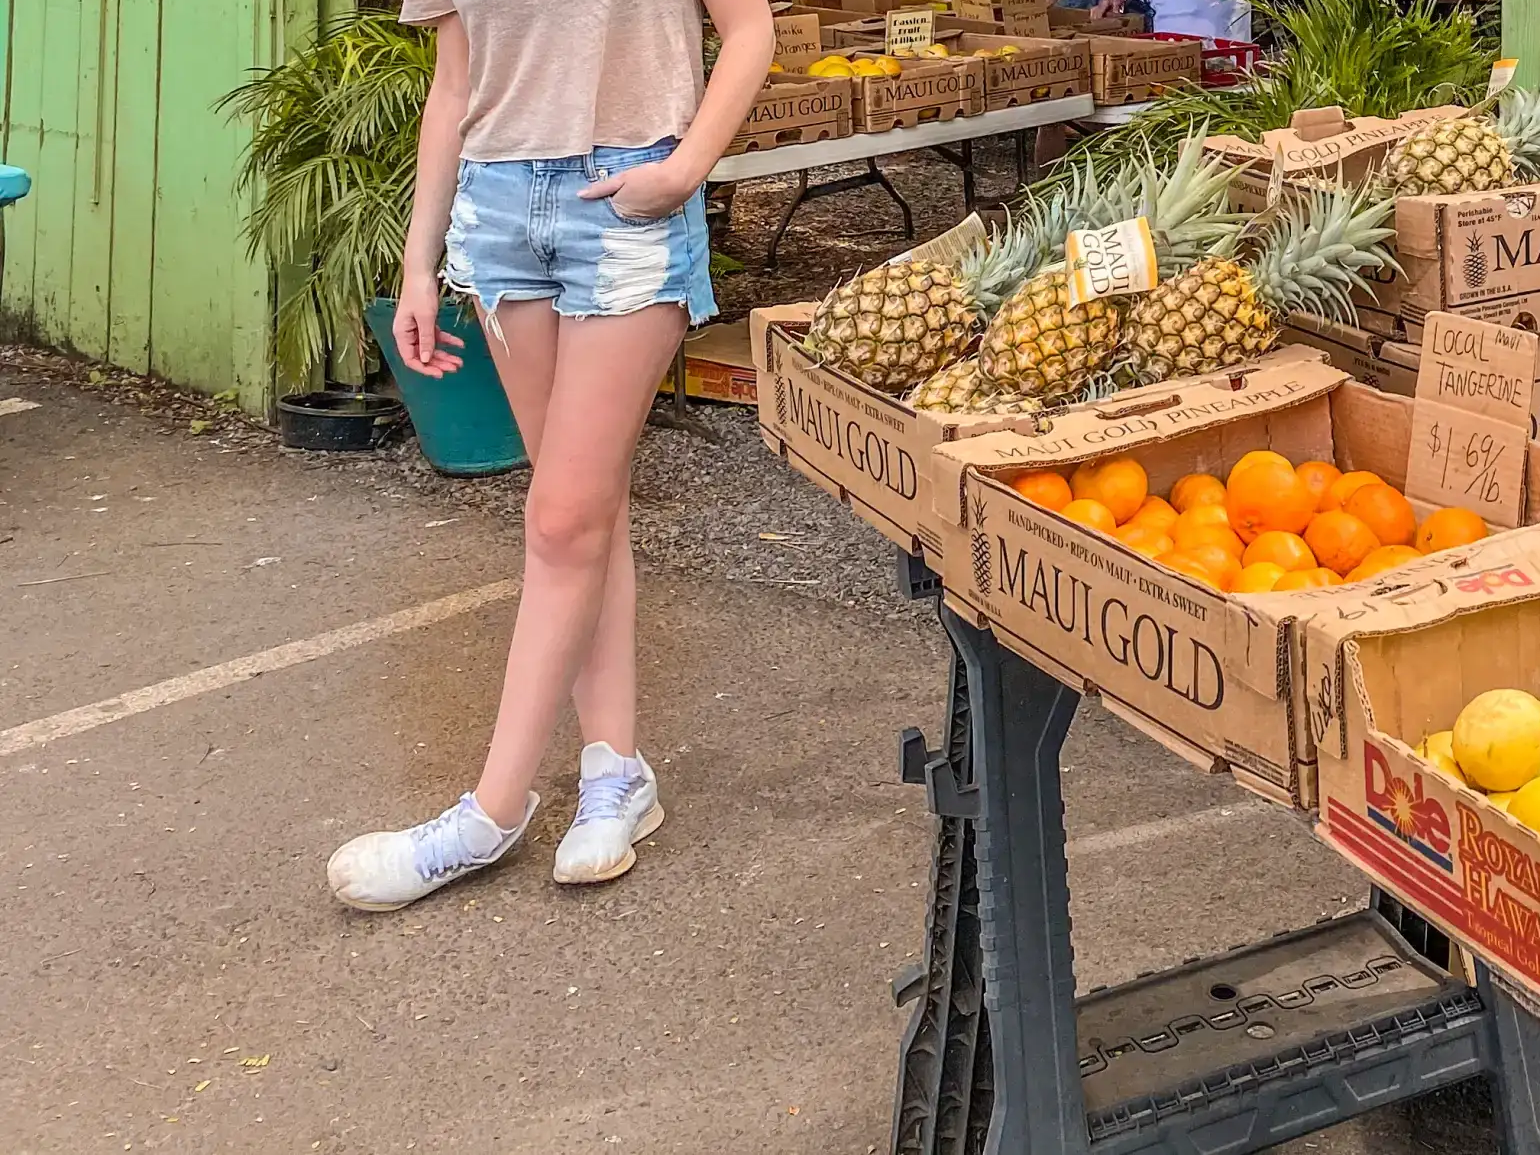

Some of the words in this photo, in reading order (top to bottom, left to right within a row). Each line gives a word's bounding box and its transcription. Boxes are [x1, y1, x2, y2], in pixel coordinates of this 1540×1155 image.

[885, 80, 934, 102] MAUI
[936, 74, 976, 96] GOLD
[1001, 63, 1046, 82] MAUI
[1047, 55, 1083, 75] GOLD
[1121, 61, 1160, 78] MAUI
[1162, 55, 1196, 72] GOLD
[799, 95, 843, 116] GOLD
[1287, 142, 1341, 164] GOLD
[1345, 113, 1445, 147] PINEAPPLE
[1082, 232, 1110, 294] GOLD
[1101, 228, 1130, 292] MAUI
[1436, 361, 1523, 408] TANGERINE
[787, 377, 845, 460] MAUI
[846, 420, 917, 501] GOLD
[994, 437, 1075, 459] MAUI
[1163, 380, 1306, 425] PINEAPPLE
[1008, 509, 1064, 549] HAND-PICKED
[1070, 541, 1089, 564] RIPE
[1090, 552, 1104, 570] ON
[1139, 576, 1171, 608] EXTRA
[1172, 595, 1208, 623] SWEET
[1455, 568, 1536, 595] Dole
[996, 534, 1095, 646] MAUI
[1100, 596, 1226, 711] GOLD
[1364, 739, 1451, 855] Dole
[1463, 908, 1513, 957] Tropical
